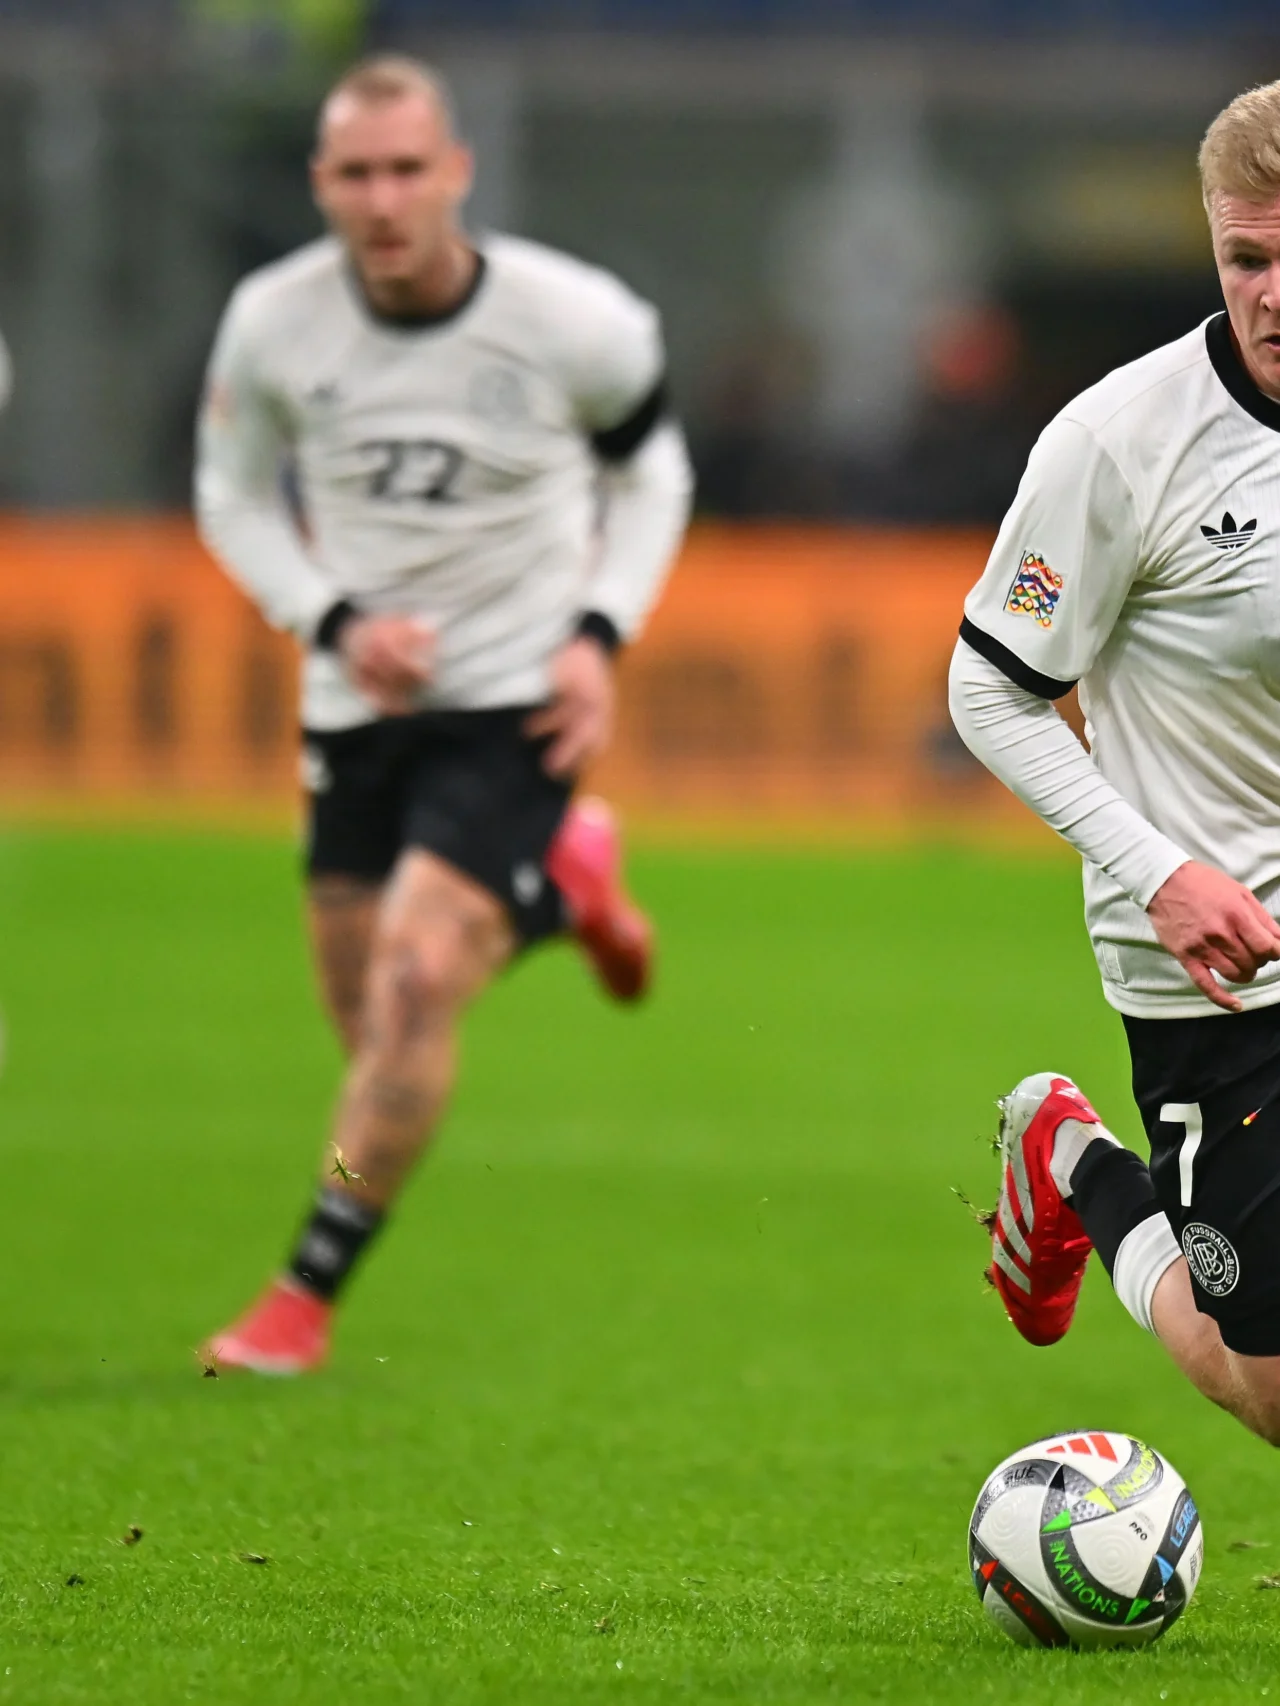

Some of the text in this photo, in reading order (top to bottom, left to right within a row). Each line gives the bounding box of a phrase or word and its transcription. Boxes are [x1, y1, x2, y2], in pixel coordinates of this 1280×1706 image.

[1159, 1102, 1203, 1207] 7
[1129, 1522, 1148, 1541] PRO
[1050, 1545, 1119, 1617] NATIONS
